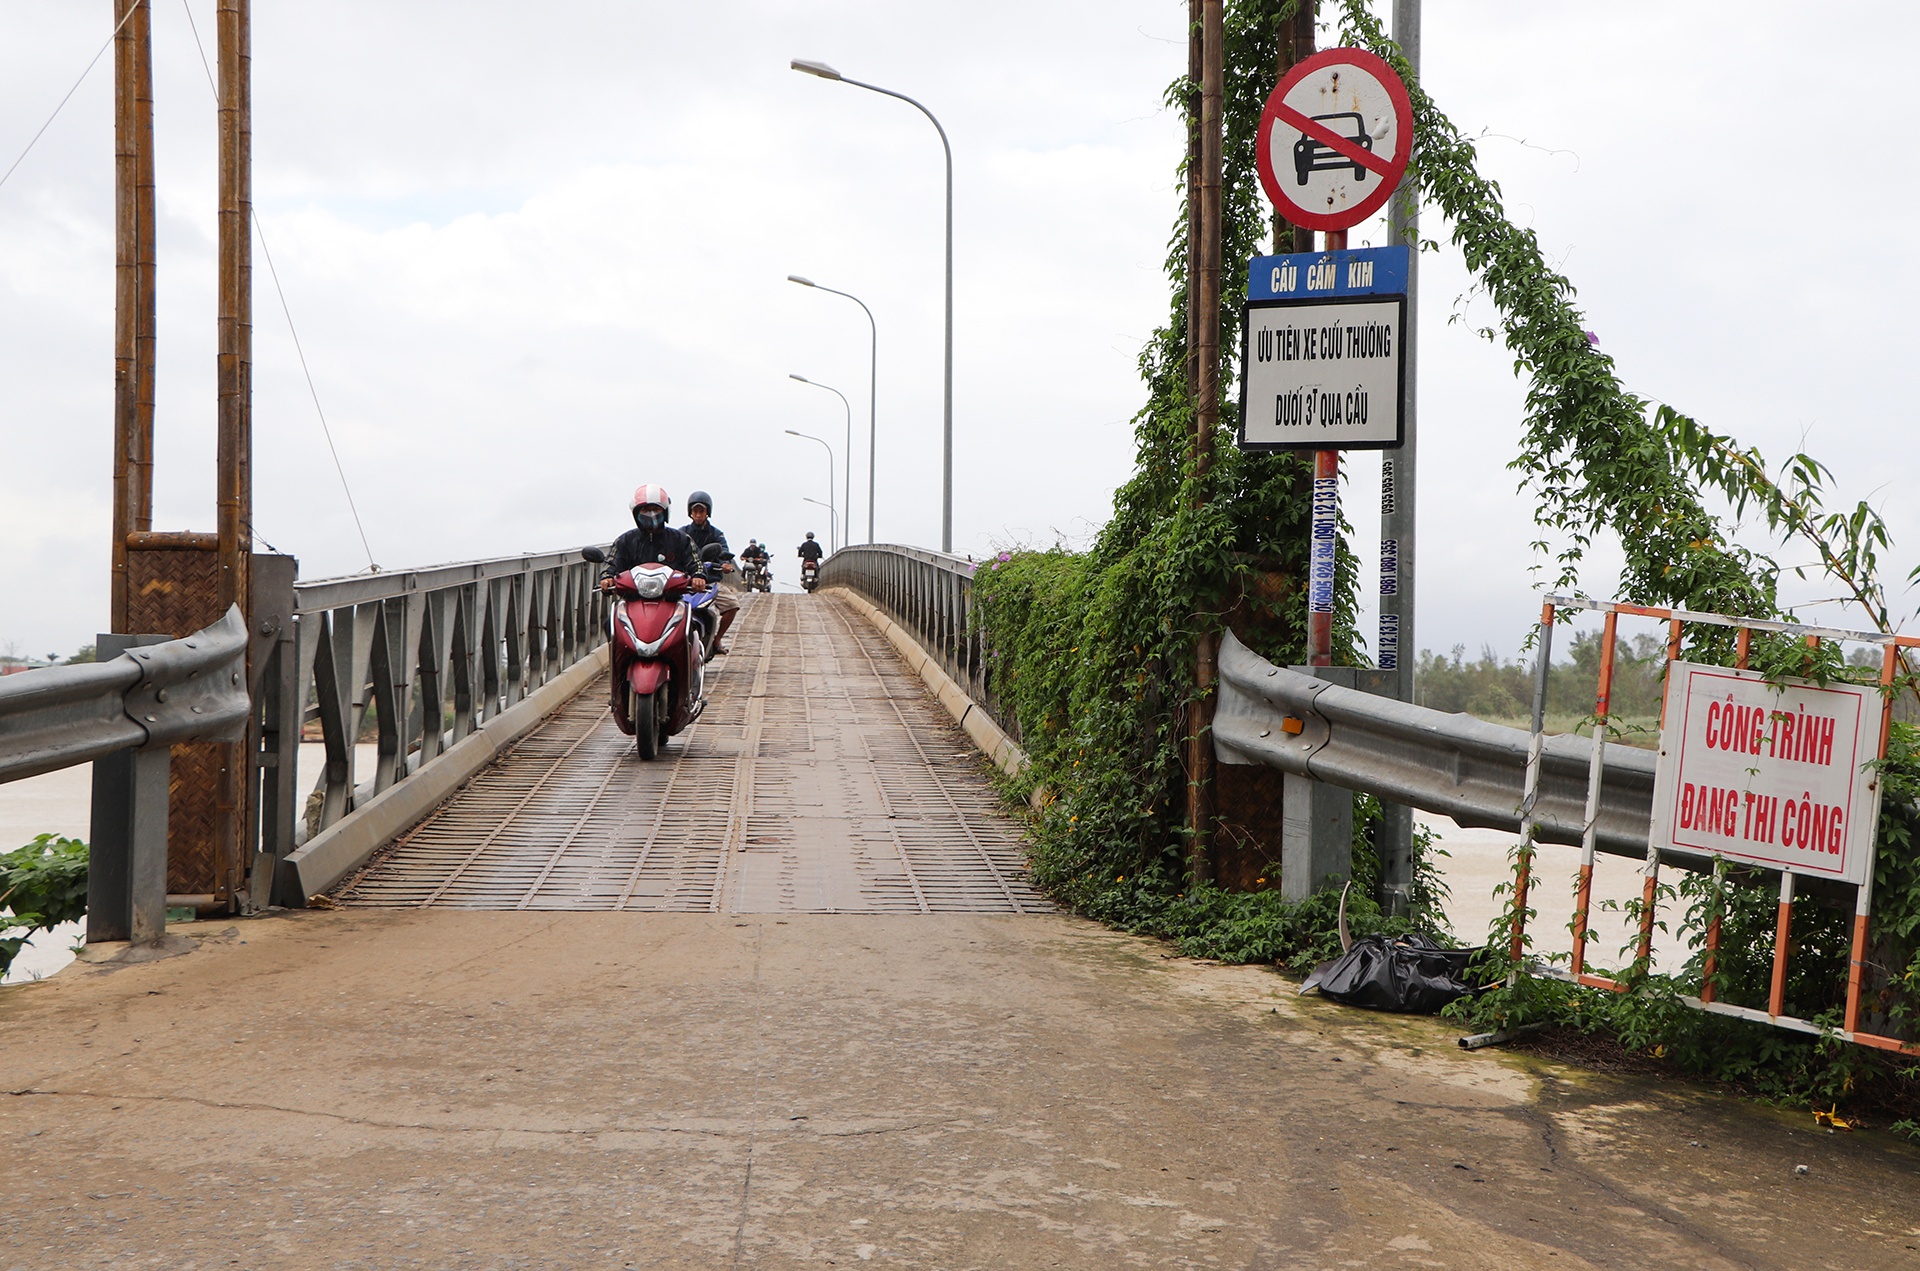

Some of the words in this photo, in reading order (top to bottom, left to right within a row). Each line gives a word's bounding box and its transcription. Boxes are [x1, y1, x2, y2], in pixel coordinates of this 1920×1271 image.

[1271, 259, 1298, 293] CẦU
[1348, 261, 1374, 289] KIM
[1257, 325, 1273, 362] ƯU
[1276, 324, 1300, 361] TIÊN
[1303, 328, 1317, 361] XE
[1320, 319, 1343, 360] CỨU
[1346, 320, 1391, 359] THƯƠNG
[1275, 386, 1303, 426] DƯỚI
[1320, 392, 1342, 428] QUA
[1345, 383, 1368, 425] CẦU
[1314, 479, 1336, 540] 0901.12.13.13
[1316, 542, 1334, 559] 394
[1316, 561, 1334, 578] 924
[1380, 540, 1397, 595] 0981.080.355
[1315, 581, 1333, 603] 0905
[1379, 615, 1398, 669] 0901.12.13.13
[1705, 693, 1765, 756] CÔNG
[1769, 703, 1836, 766] TRÌNH
[1680, 782, 1739, 838] ĐANG
[1743, 792, 1778, 844] THI
[1781, 791, 1843, 855] CÔNG
